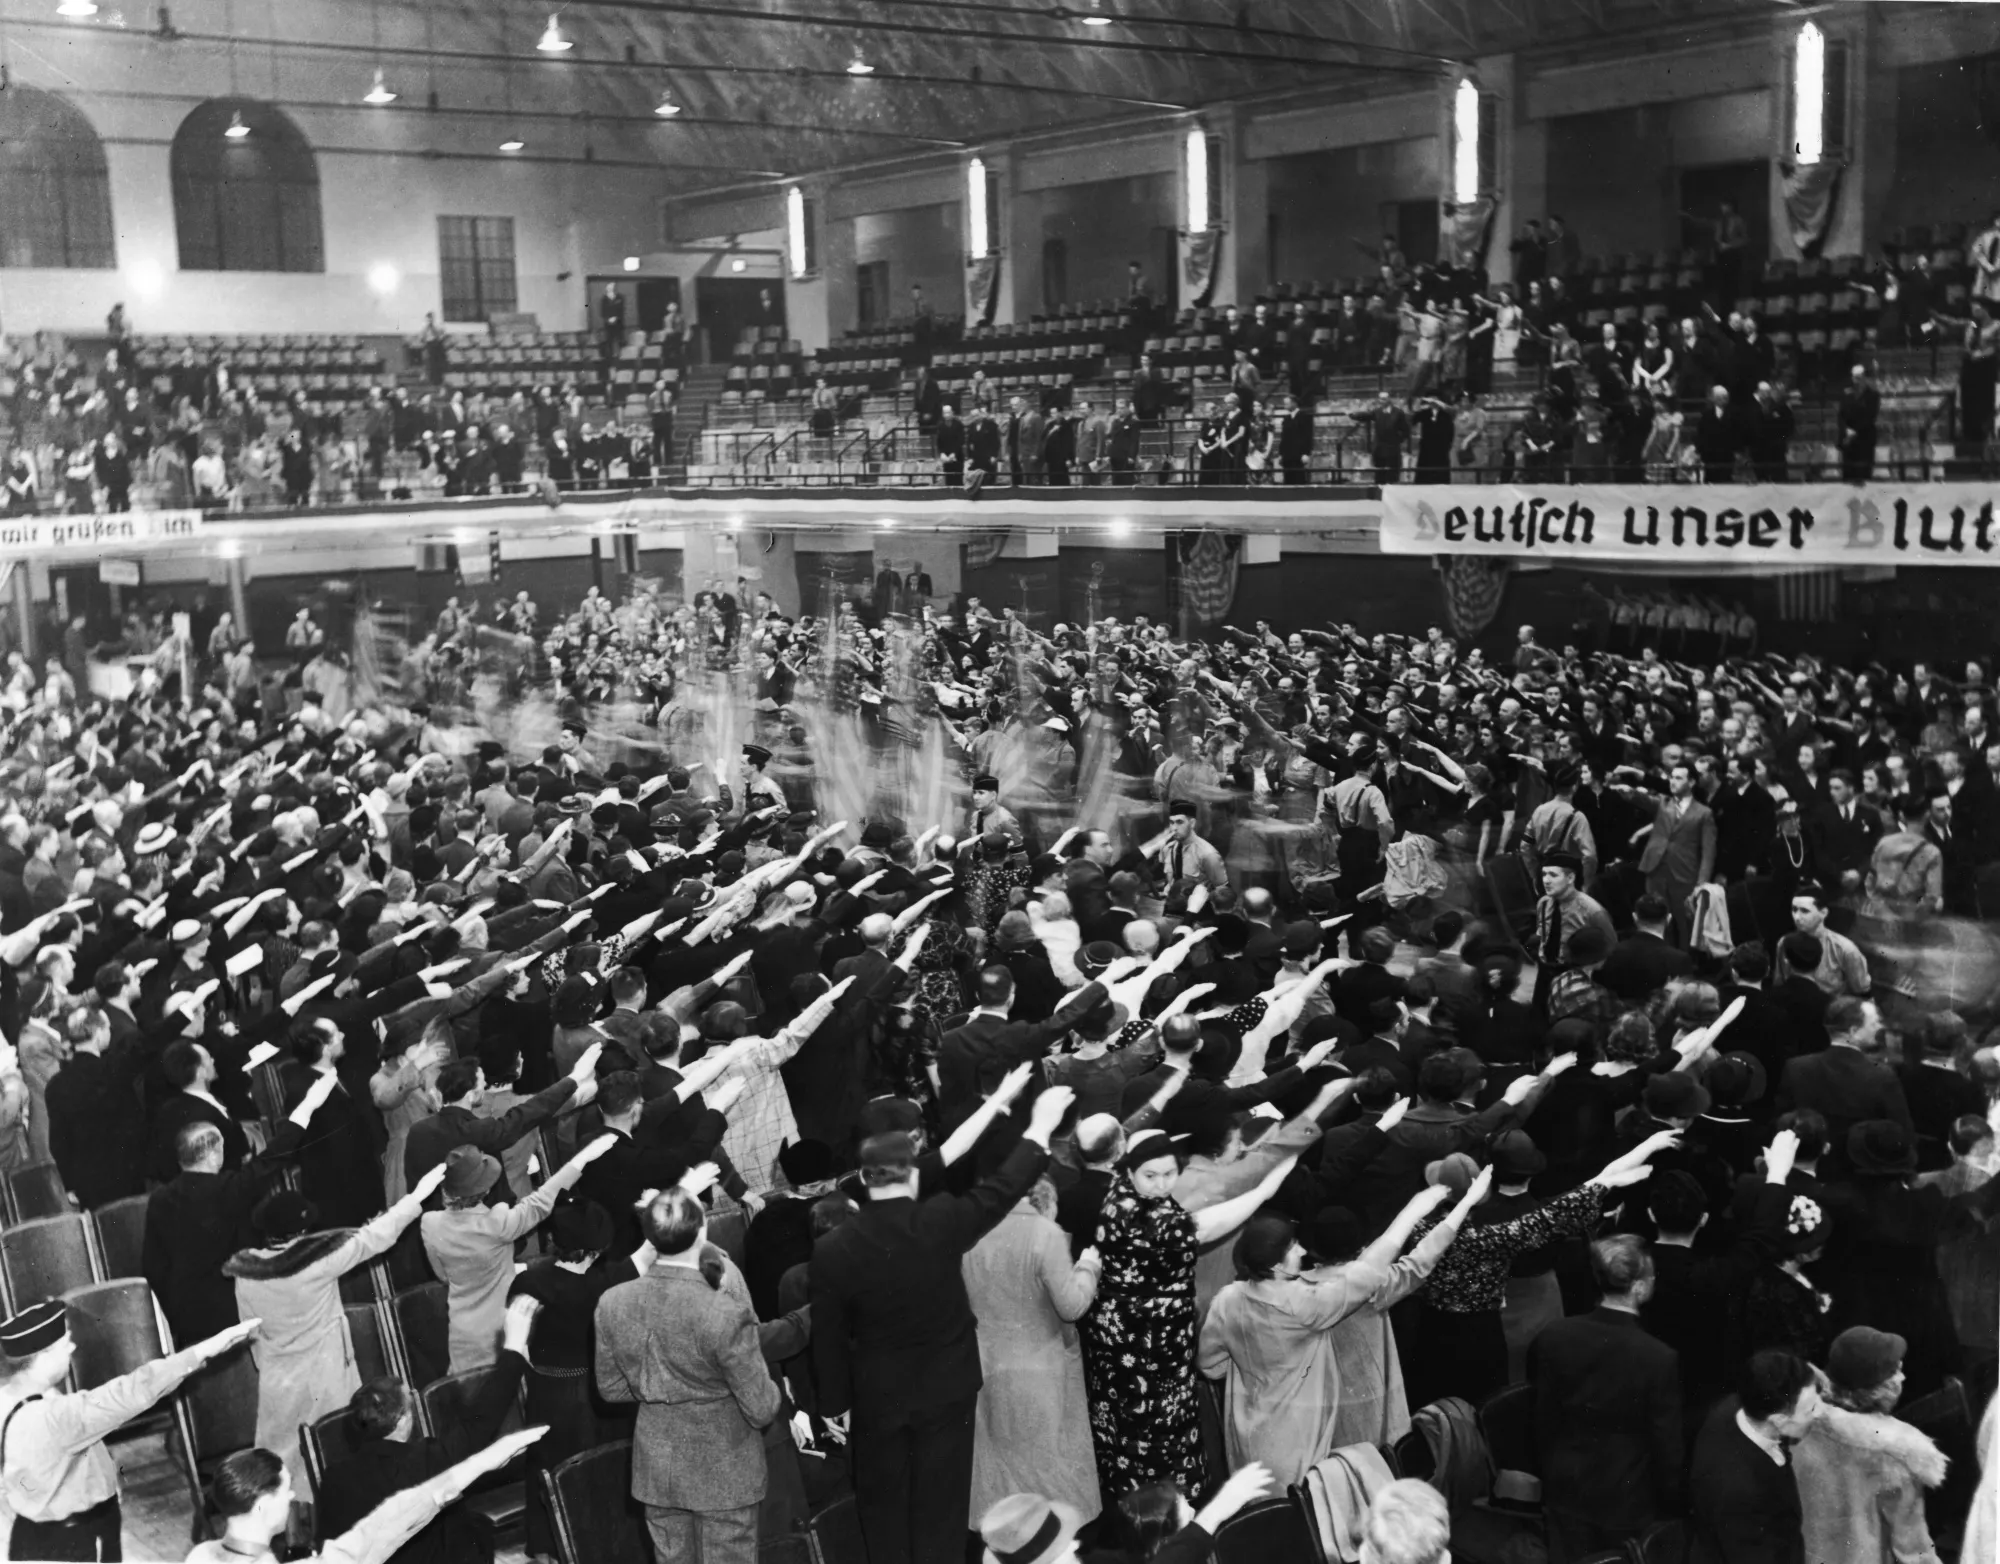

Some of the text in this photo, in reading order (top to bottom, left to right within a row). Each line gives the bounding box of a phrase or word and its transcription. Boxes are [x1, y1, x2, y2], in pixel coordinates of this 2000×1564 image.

[150, 516, 194, 536] ich
[1623, 506, 1815, 550] unser
[1844, 497, 1994, 552] Blut
